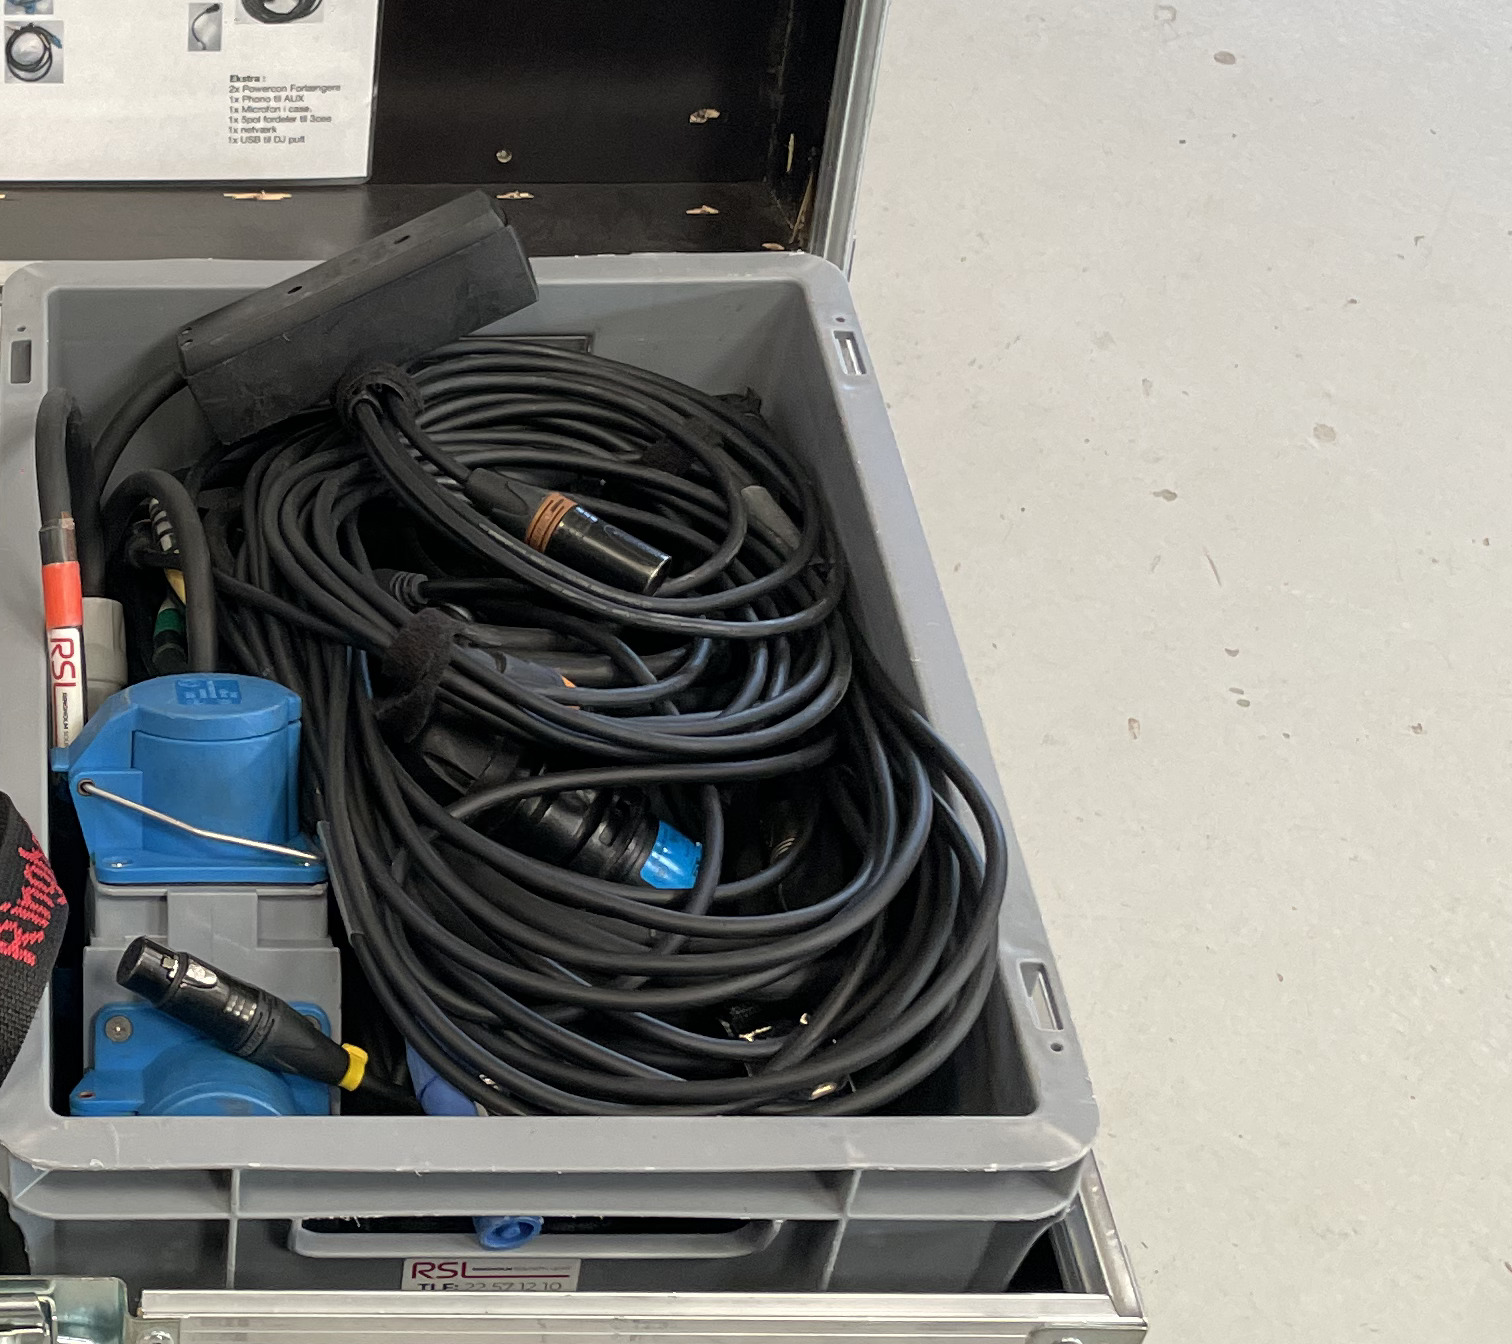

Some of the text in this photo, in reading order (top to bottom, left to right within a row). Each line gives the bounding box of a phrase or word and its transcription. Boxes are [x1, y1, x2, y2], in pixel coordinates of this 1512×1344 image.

[242, 85, 287, 93] Powercon
[242, 95, 271, 103] Phono
[240, 135, 261, 144] USB
[50, 637, 77, 687] RSL
[411, 1261, 467, 1279] RSL
